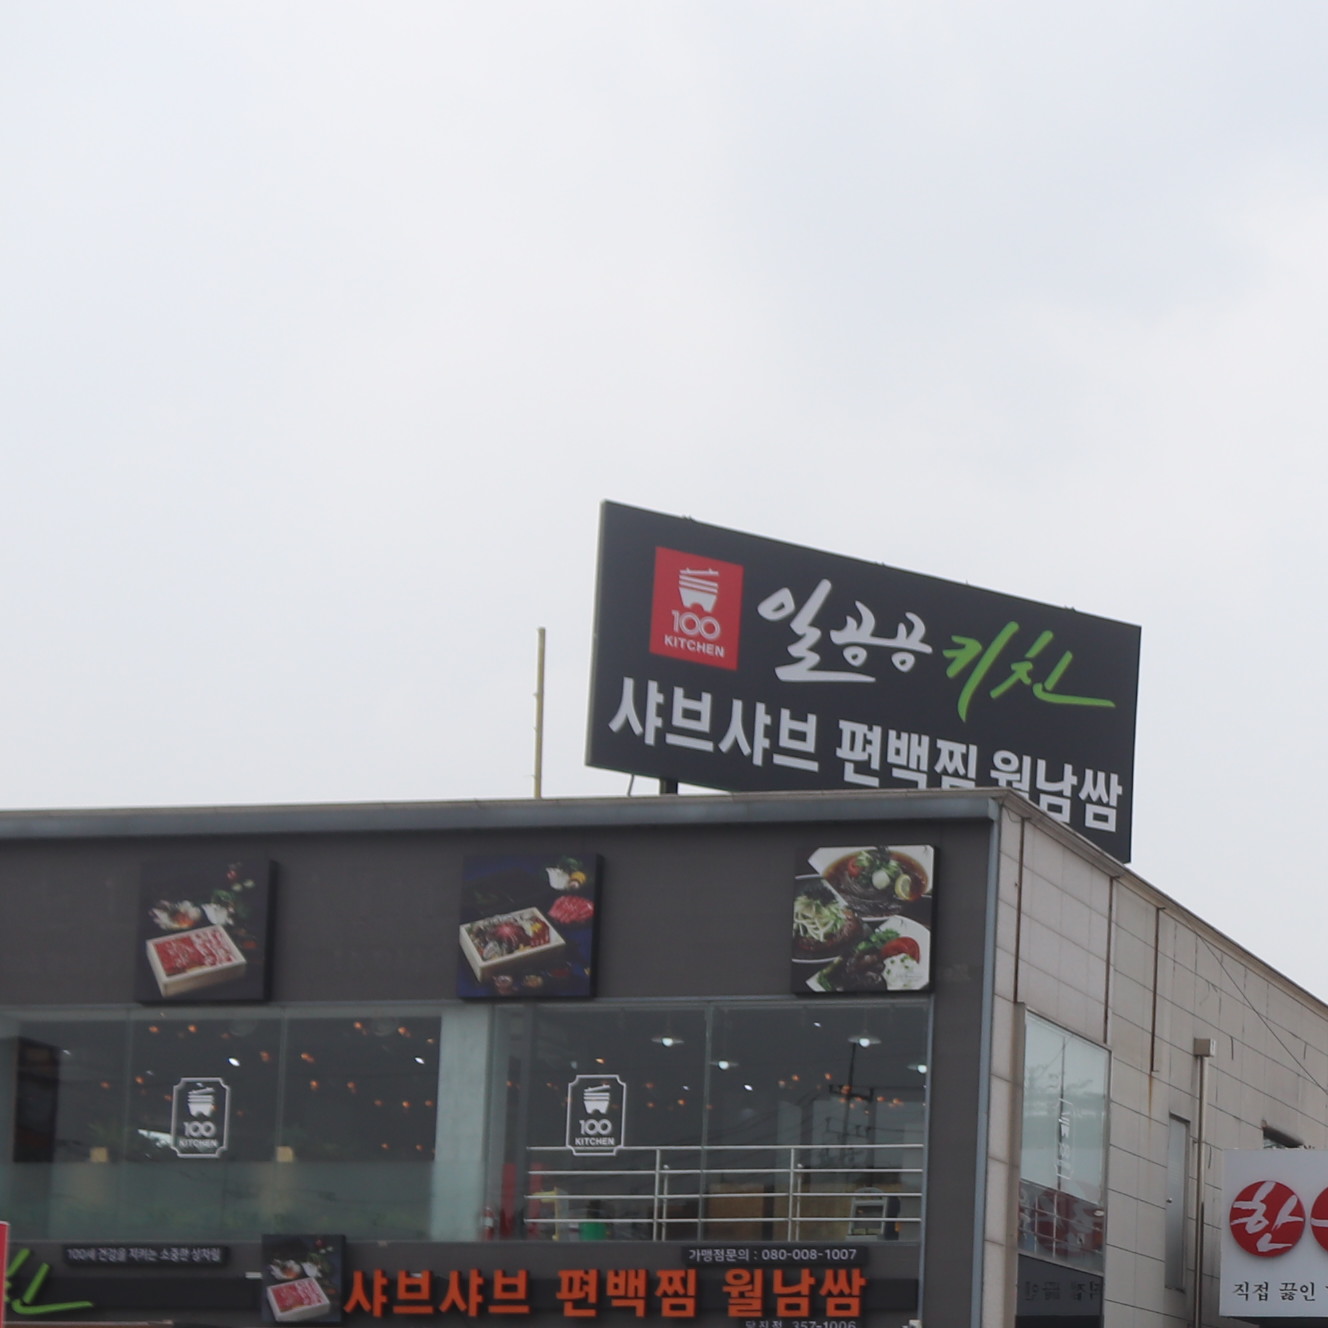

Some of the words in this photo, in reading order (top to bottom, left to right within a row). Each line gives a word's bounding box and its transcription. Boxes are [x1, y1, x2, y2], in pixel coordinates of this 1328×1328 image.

[672, 609, 721, 641] 100
[664, 634, 725, 657] KITCHEN
[756, 578, 933, 682] 일공공
[943, 620, 1115, 722] 키친
[608, 676, 820, 772] 샤브샤브
[835, 720, 978, 790] 편백찜
[183, 1121, 216, 1138] 100
[579, 1118, 613, 1135] 100
[575, 1137, 615, 1146] KITCHEN
[689, 1249, 750, 1262] 가맹점문의
[762, 1249, 858, 1262] 080-008-1007
[343, 1268, 531, 1317] 샤브샤브
[556, 1268, 697, 1318] 편백찜
[722, 1267, 867, 1318] 월남쌈
[1233, 1282, 1269, 1302] 직접
[1279, 1282, 1316, 1303] 끓인
